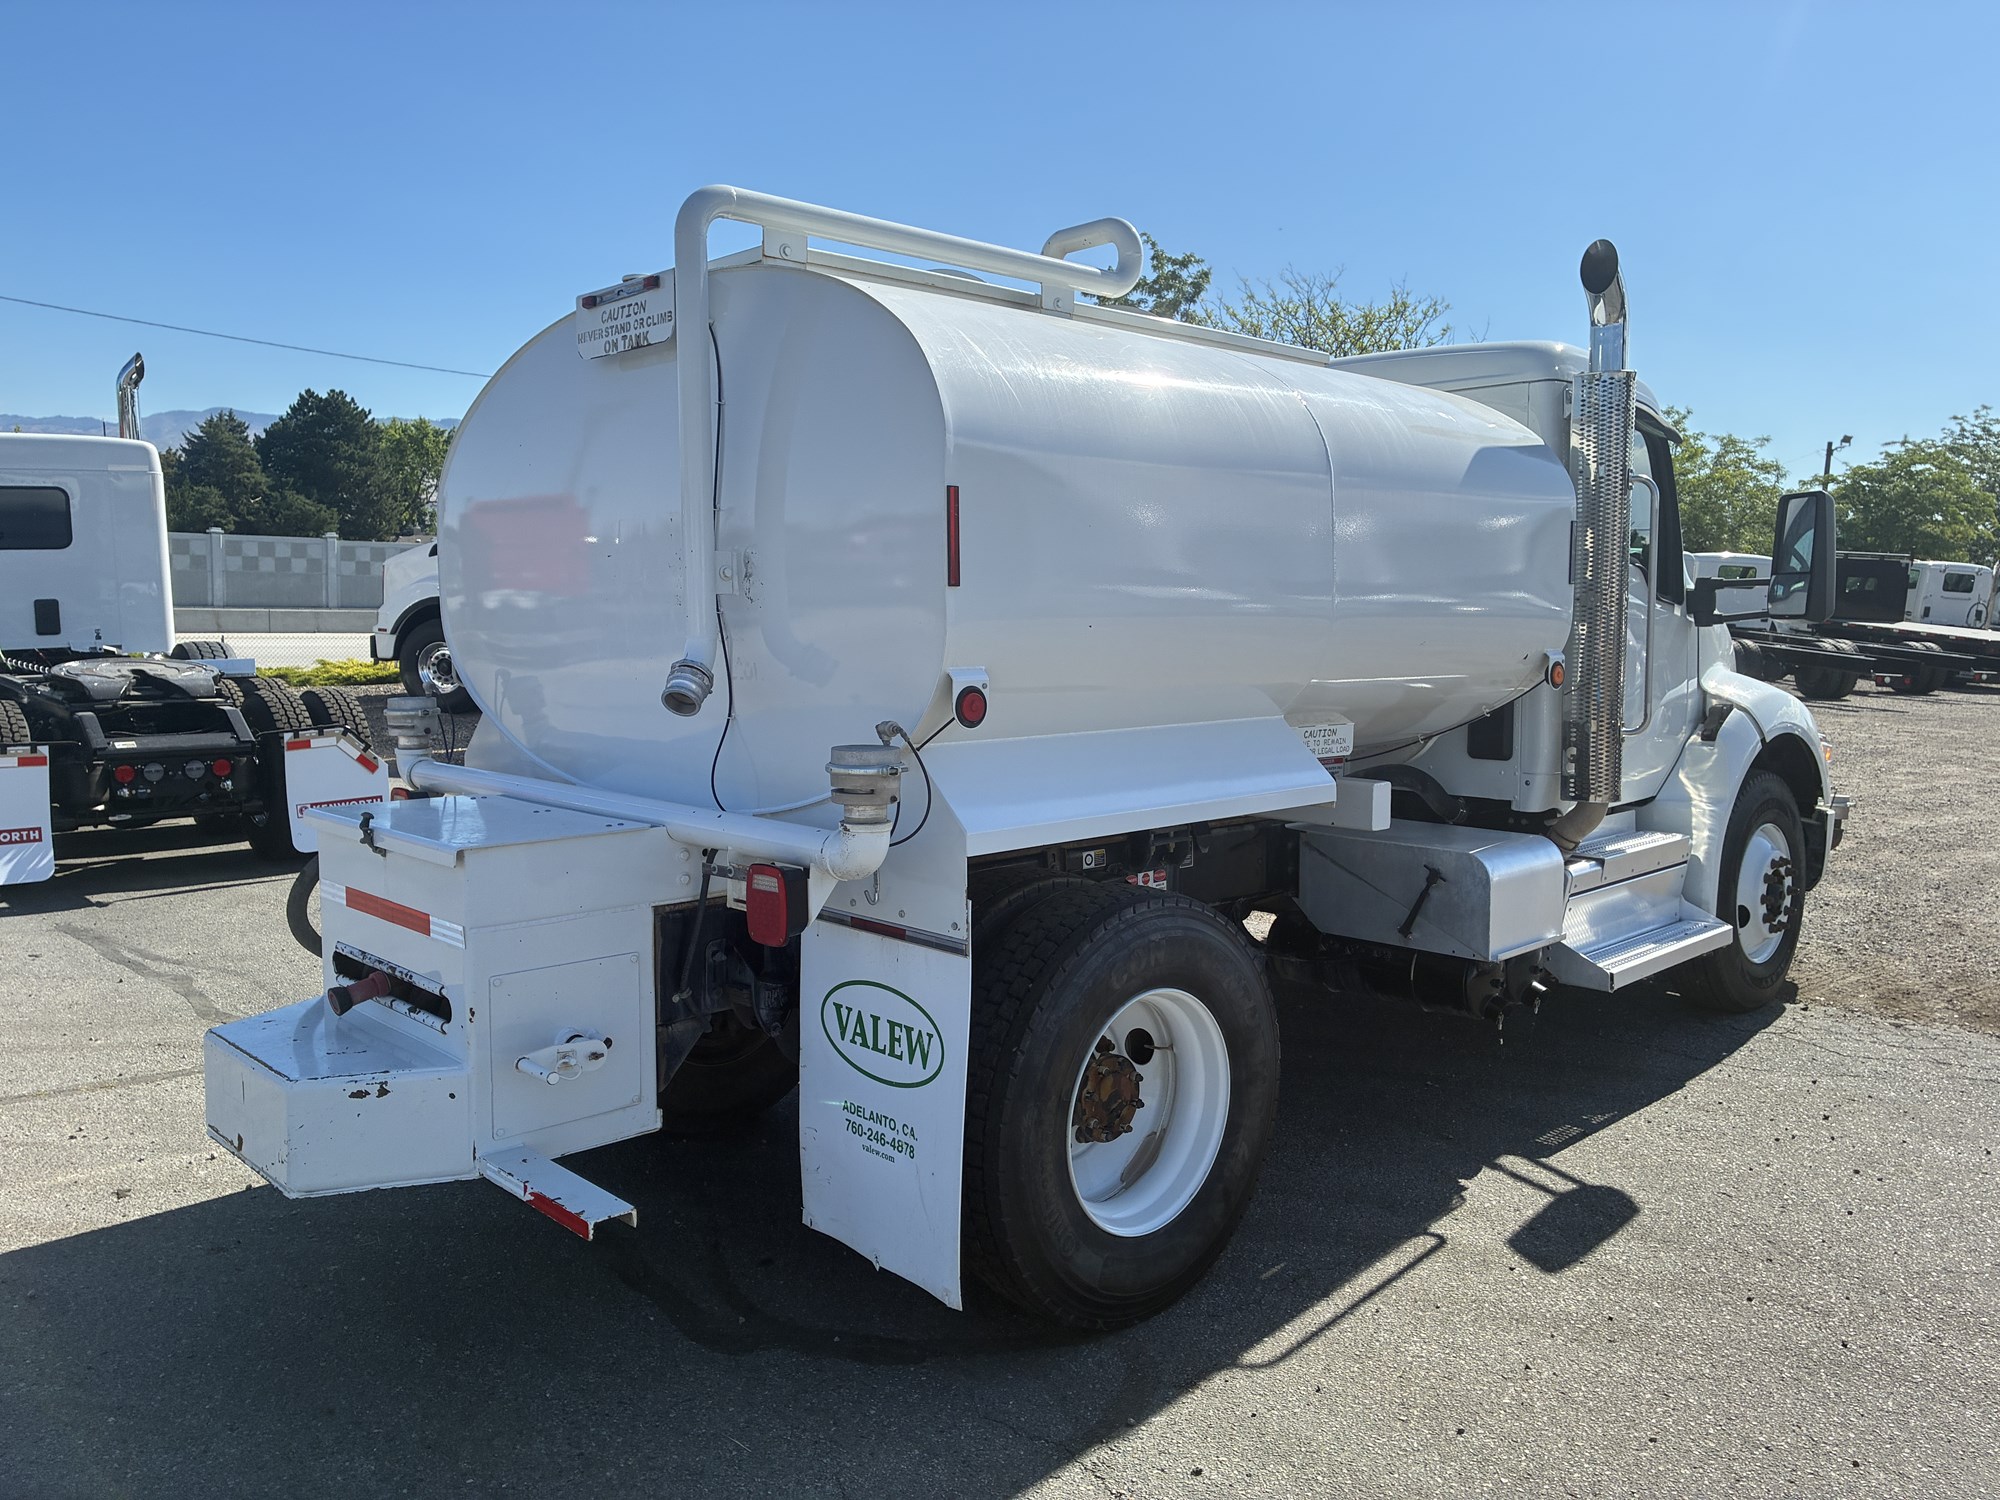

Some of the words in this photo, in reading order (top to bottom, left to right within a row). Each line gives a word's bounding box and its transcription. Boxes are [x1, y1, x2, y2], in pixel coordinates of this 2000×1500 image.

[601, 300, 647, 324] CAUTION
[604, 321, 631, 338] STAND
[633, 318, 645, 331] OR
[646, 310, 673, 328] CLIMB
[604, 338, 618, 354] ON
[621, 331, 650, 350] TANK
[1303, 728, 1338, 739] CAUTION
[1313, 739, 1321, 747] TO
[1323, 737, 1347, 746] REMAIN
[1317, 746, 1335, 755] LEGAL
[832, 1001, 934, 1071] VALEW
[842, 1100, 900, 1136] ADELANTO,
[902, 1123, 918, 1142] CA.
[844, 1118, 915, 1160] 760-246-4878
[861, 1143, 896, 1164] valew.com
